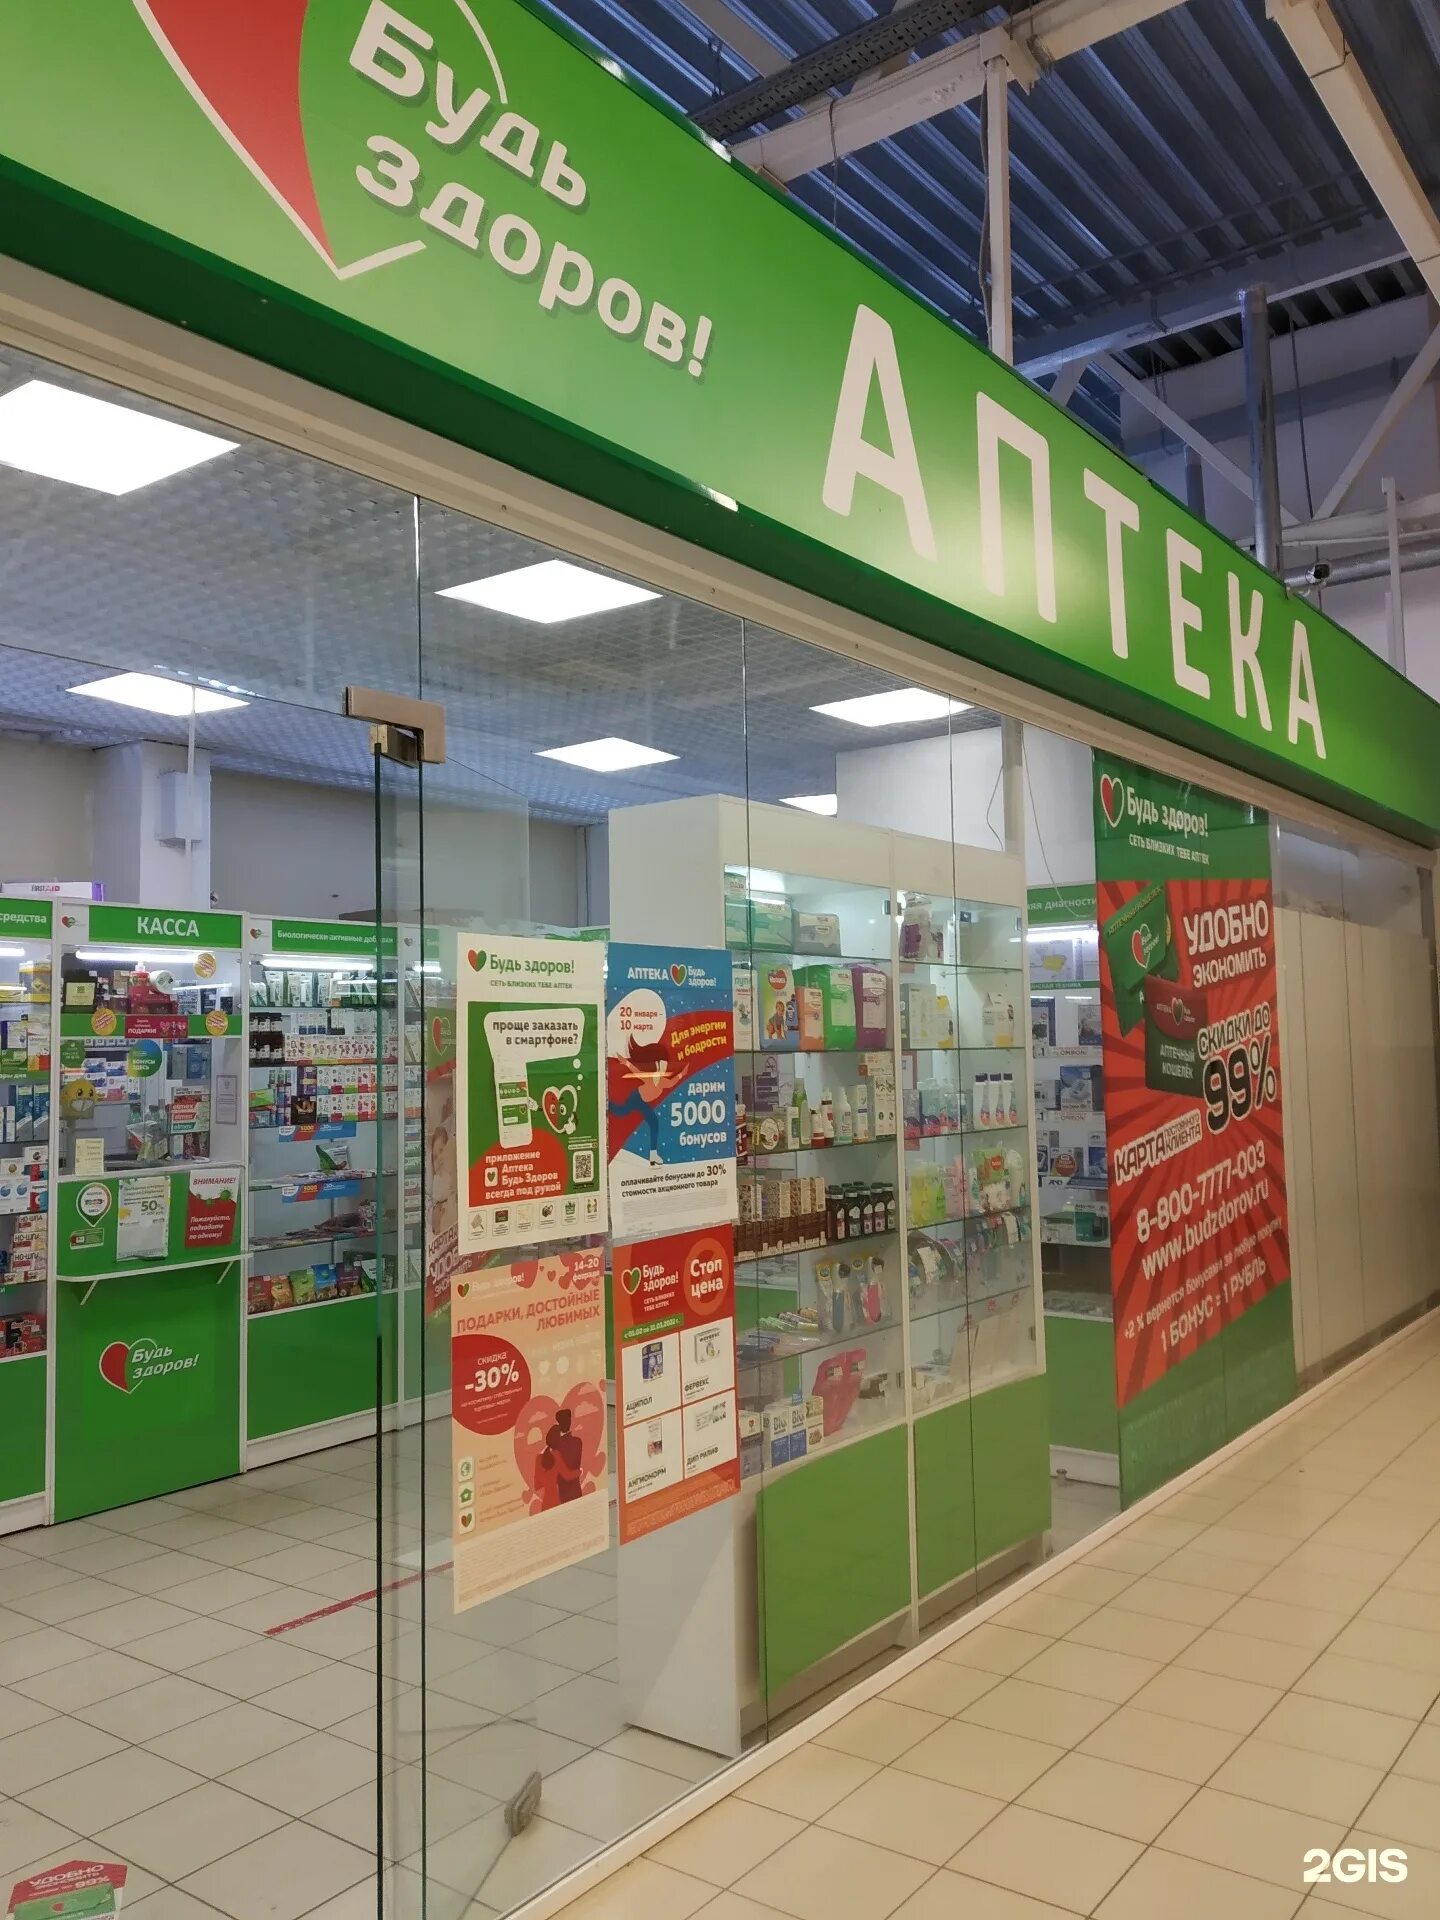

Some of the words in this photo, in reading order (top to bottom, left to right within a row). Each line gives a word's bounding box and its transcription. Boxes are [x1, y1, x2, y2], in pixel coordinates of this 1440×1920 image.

[349, 0, 587, 207] Будь
[356, 135, 712, 377] здоров!
[822, 304, 1327, 759] АПТЕКА
[1127, 786, 1158, 825] Будь
[1161, 805, 1209, 839] здоров!
[1128, 834, 1145, 849] СЕТЬ
[1146, 837, 1175, 856] БЛИЗКИХ
[1176, 846, 1191, 860] ТЕБЕ
[1191, 851, 1209, 865] АПТЕК
[137, 916, 199, 937] КАССА
[278, 930, 328, 941] Биологически
[1183, 900, 1269, 956] УДОБНО
[490, 954, 521, 974] Будь
[525, 960, 575, 976] здоров!
[627, 967, 669, 980] АПТЕКА
[688, 966, 705, 977] Будь
[1193, 947, 1266, 988] ЭКОНОМИТЬ
[688, 977, 717, 988] здоров!
[620, 1007, 632, 1017] 20
[493, 1021, 529, 1033] проще
[532, 1021, 578, 1031] заказать
[620, 1020, 632, 1030] 10
[633, 1024, 653, 1032] марта
[671, 1030, 690, 1047] Для
[690, 1021, 727, 1036] энергии
[1198, 1008, 1251, 1056] СКИДКИ
[1254, 1002, 1270, 1032] ДО
[506, 1037, 512, 1045] в
[515, 1033, 578, 1047] смартфоне?
[678, 1051, 684, 1060] и
[684, 1035, 727, 1056] бодрости
[1159, 1043, 1195, 1062] АПТЕЧНЫЙ
[1162, 1062, 1194, 1078] КОШЕЛЁК
[688, 1081, 725, 1097] дарим
[1203, 1032, 1277, 1134] 99%
[670, 1100, 726, 1127] 5000
[679, 1131, 727, 1148] бонусов
[1165, 1123, 1200, 1151] КЛИЕНТА
[486, 1151, 540, 1165] приложение
[1115, 1132, 1165, 1181] КАРТА
[502, 1164, 534, 1175] Аптека
[502, 1175, 523, 1187] Будь
[525, 1172, 558, 1184] Здоров
[621, 1175, 663, 1187] оплачивайте
[665, 1172, 695, 1183] бонусами
[706, 1164, 726, 1177] 30%
[192, 1177, 237, 1186] ВНИМАНИЕ!
[485, 1188, 515, 1200] всегда
[516, 1187, 533, 1197] под
[534, 1182, 561, 1196] рукой
[621, 1187, 657, 1197] стоимости
[696, 1180, 718, 1189] товара
[1136, 1139, 1265, 1243] 8-800-7777-003
[1142, 1178, 1269, 1280] www.budzdorov.ru
[642, 1264, 664, 1279] Будь
[690, 1258, 722, 1277] Стоп
[643, 1271, 679, 1292] здоров!
[691, 1277, 723, 1298] цена
[457, 1309, 523, 1333] ПОДАРКИ,
[526, 1289, 600, 1318] ДОСТОЙНЫЕ
[1169, 1294, 1213, 1347] БОНУС
[1230, 1256, 1266, 1297] РУБЛЬ
[536, 1305, 600, 1331] ЛЮБИМЫХ
[132, 1347, 173, 1364] Будь
[133, 1354, 199, 1379] здоров!
[477, 1352, 507, 1366] скидка
[465, 1360, 519, 1392] -30%
[684, 1377, 709, 1392] ФЕРВЕКС
[626, 1396, 652, 1411] АЦИПОЛ
[628, 1467, 667, 1488] АНГИОНОРМ
[28, 1864, 104, 1887] УДОБНО
